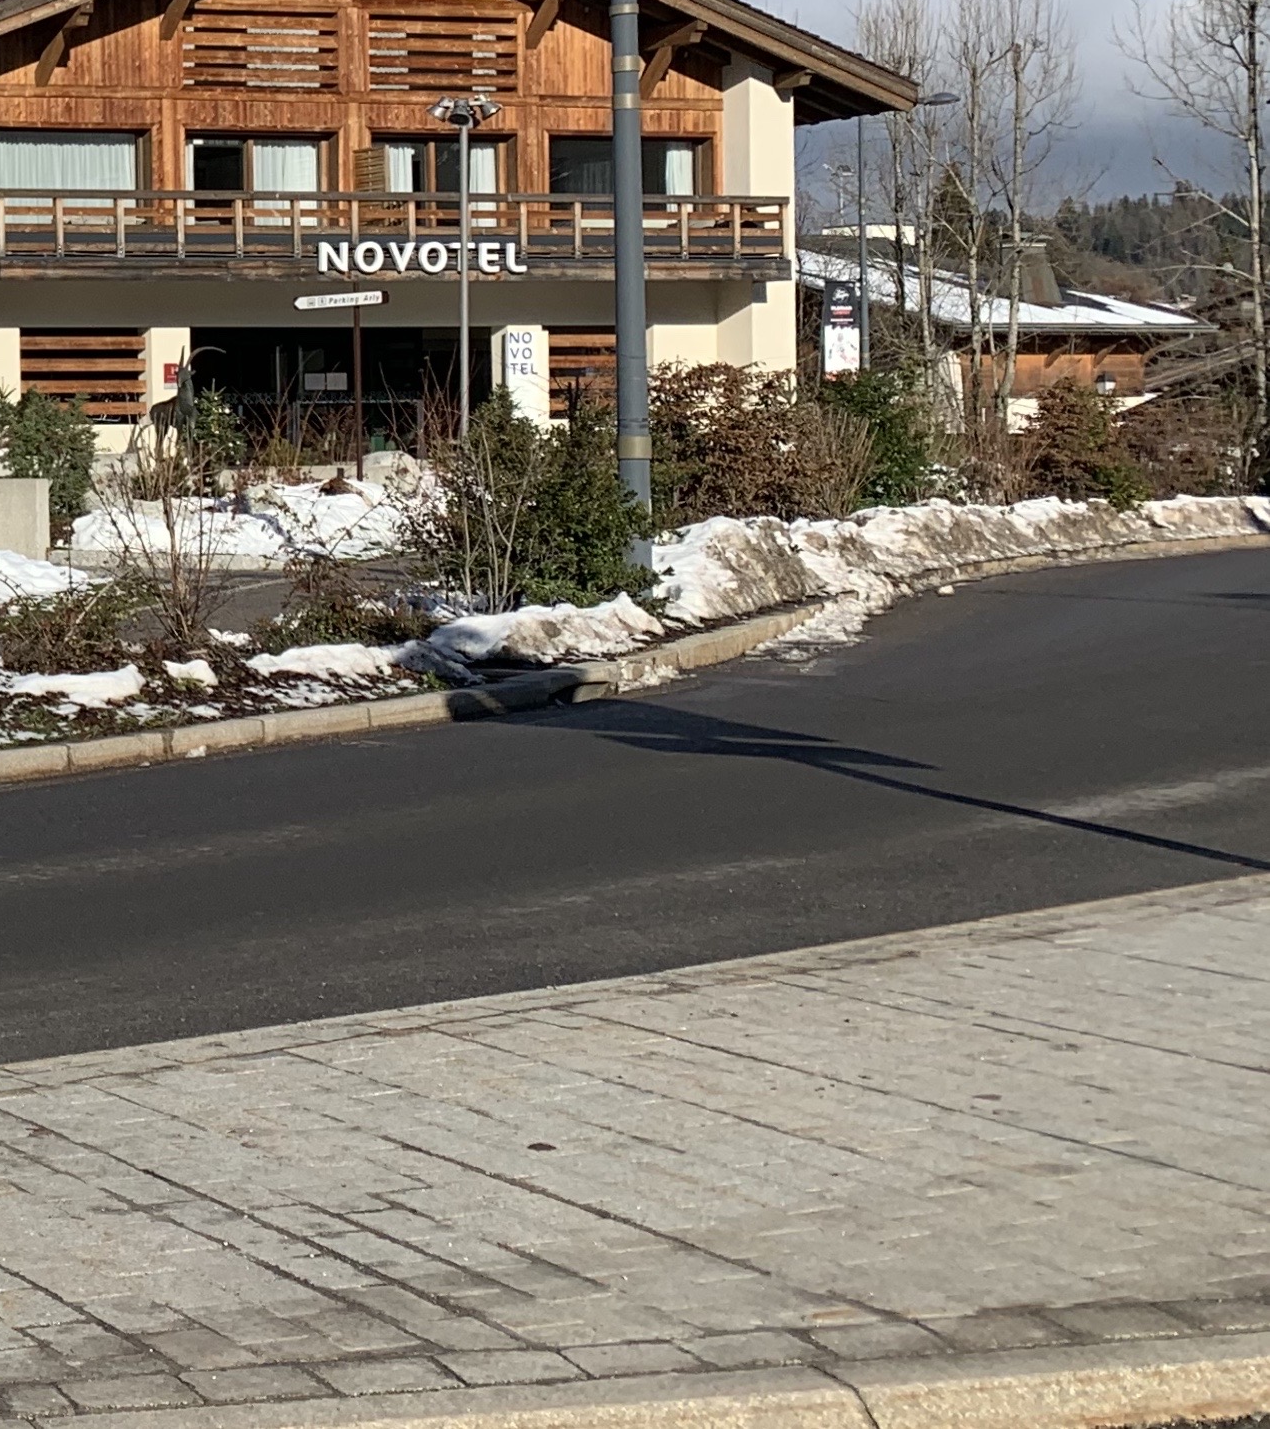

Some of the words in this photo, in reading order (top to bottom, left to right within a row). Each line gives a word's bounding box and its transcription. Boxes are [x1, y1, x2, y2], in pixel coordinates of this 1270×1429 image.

[318, 241, 528, 273] NOVOTEL
[328, 295, 359, 305] Parking
[509, 332, 532, 344] NO
[510, 347, 532, 359] VO
[510, 363, 538, 375] TEL
